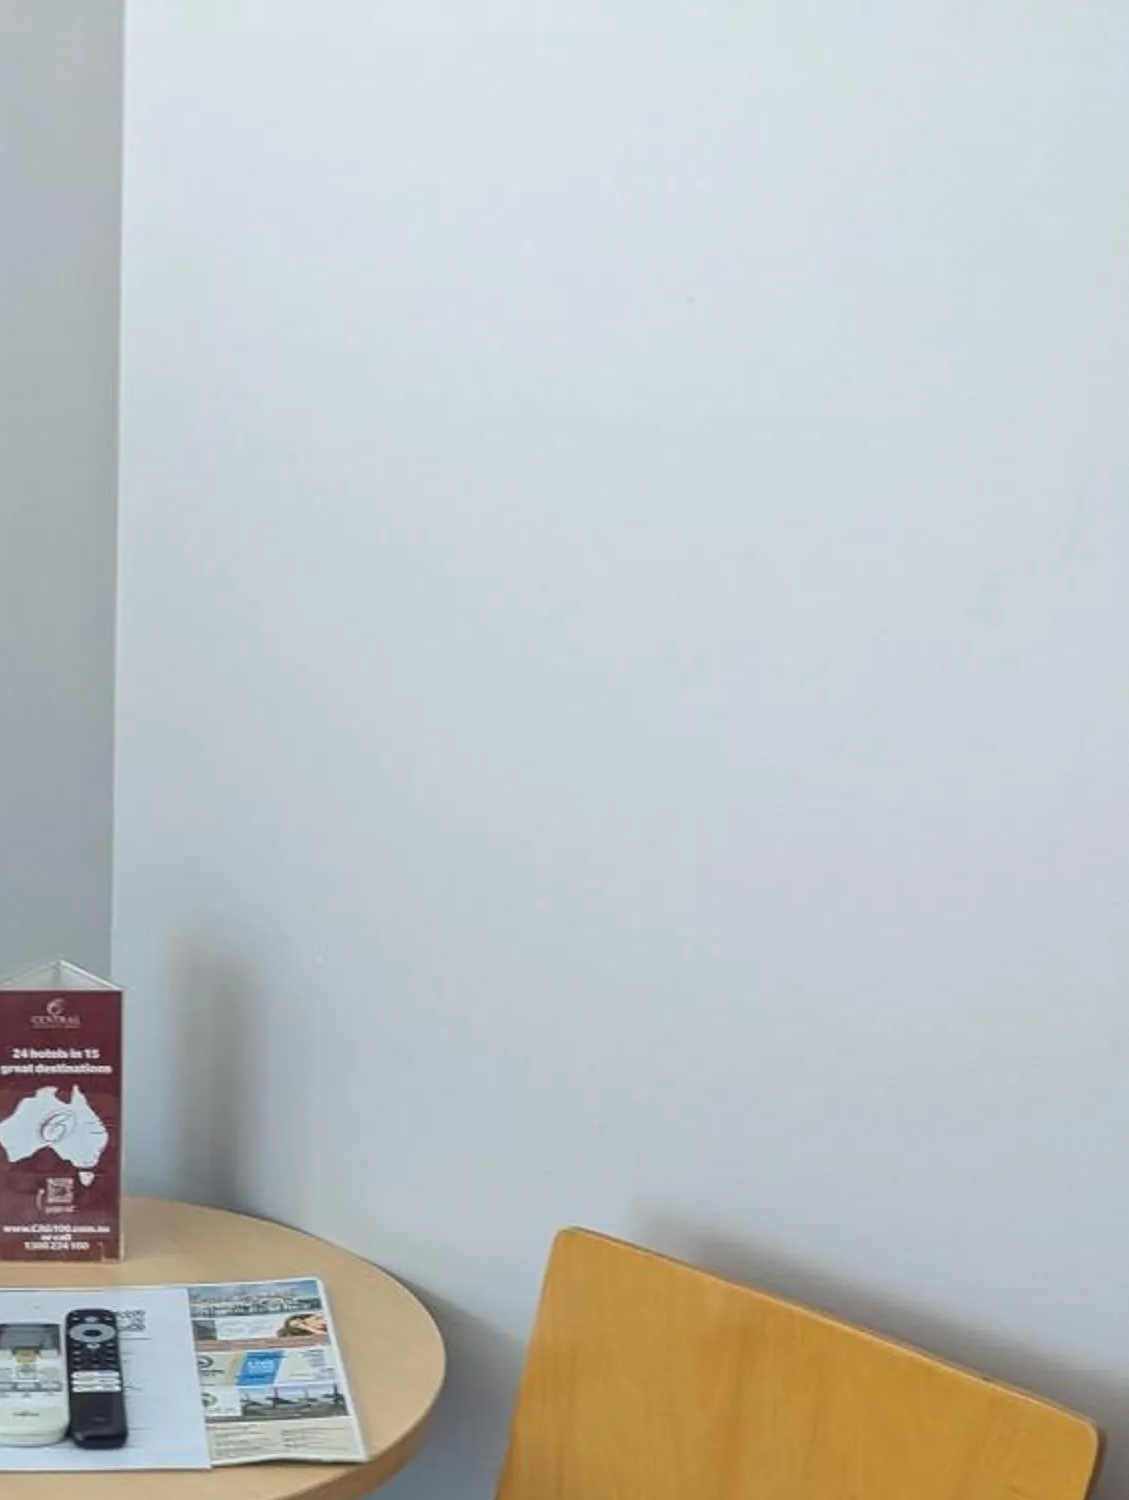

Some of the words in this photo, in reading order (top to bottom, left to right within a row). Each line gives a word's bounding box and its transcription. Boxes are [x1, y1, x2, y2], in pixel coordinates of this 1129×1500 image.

[12, 1048, 28, 1059] 24
[30, 1048, 69, 1059] hotels
[70, 1048, 83, 1059] in
[84, 1048, 100, 1059] 15
[0, 1063, 34, 1075] great
[34, 1062, 113, 1074] destinations
